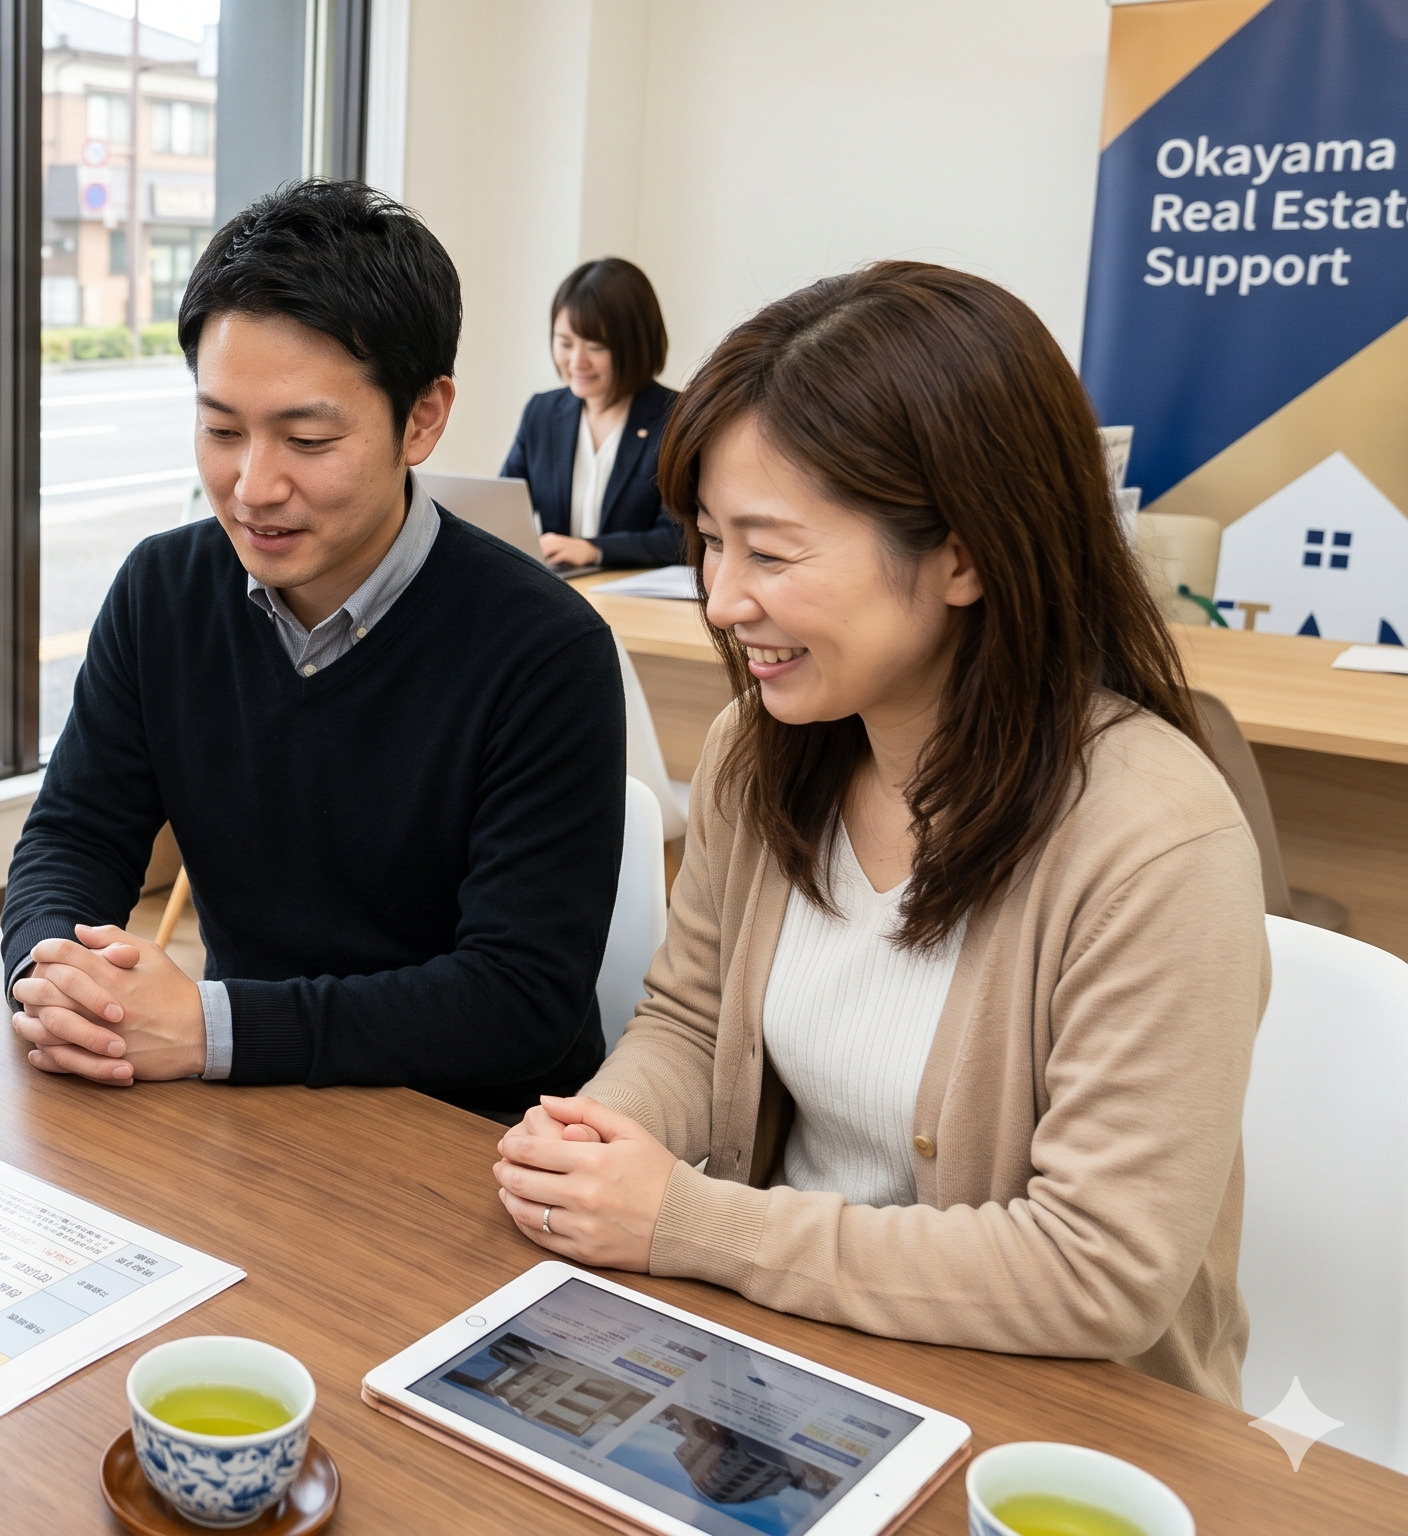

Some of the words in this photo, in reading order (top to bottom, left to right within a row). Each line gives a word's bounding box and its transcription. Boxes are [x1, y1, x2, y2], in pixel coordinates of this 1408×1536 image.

[1156, 135, 1396, 185] Okayama
[1151, 188, 1257, 232] Real
[1272, 189, 1408, 230] Estat
[1143, 247, 1352, 296] Support
